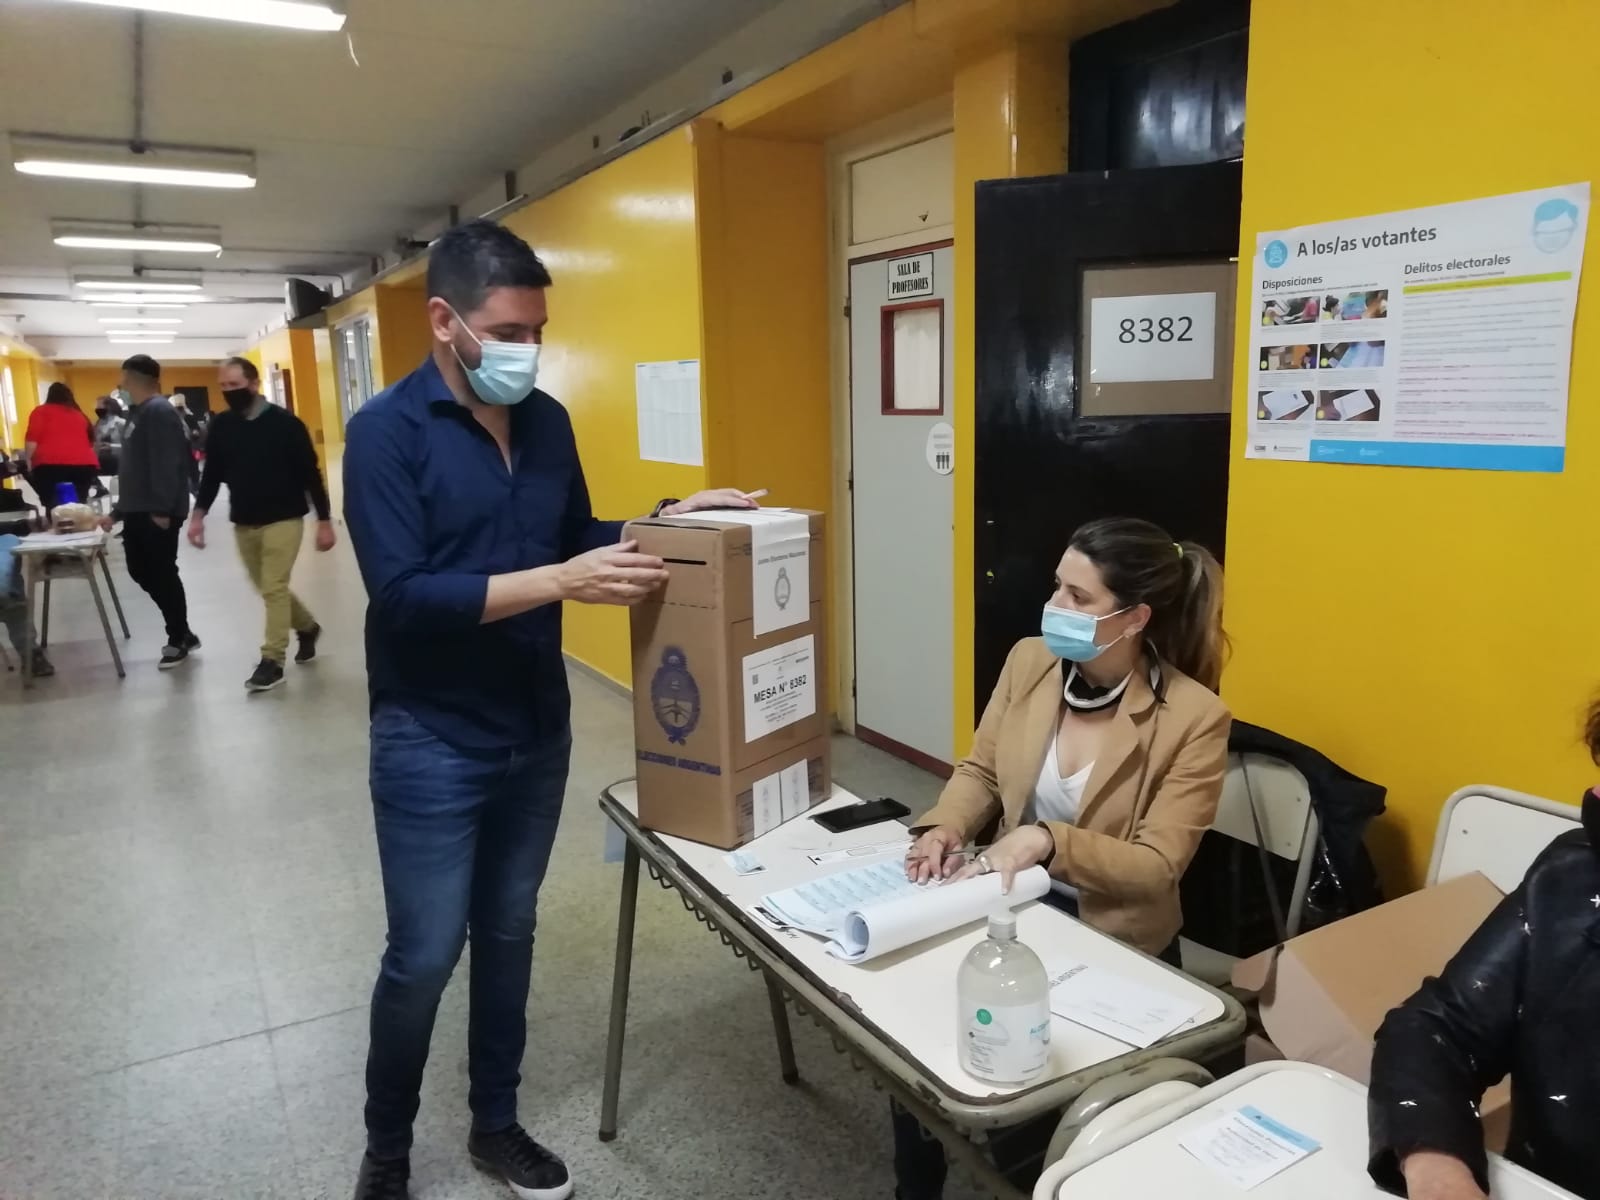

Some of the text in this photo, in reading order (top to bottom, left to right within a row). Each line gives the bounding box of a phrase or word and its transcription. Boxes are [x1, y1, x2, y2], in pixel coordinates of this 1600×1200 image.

[1297, 227, 1437, 257] A los/as votantes
[897, 260, 920, 276] SALA DE
[1404, 254, 1511, 275] Delitos electorales
[892, 277, 929, 294] PROFESORES
[1262, 275, 1323, 290] Disposiciones
[1118, 316, 1193, 344] 8382
[754, 686, 777, 703] MESA
